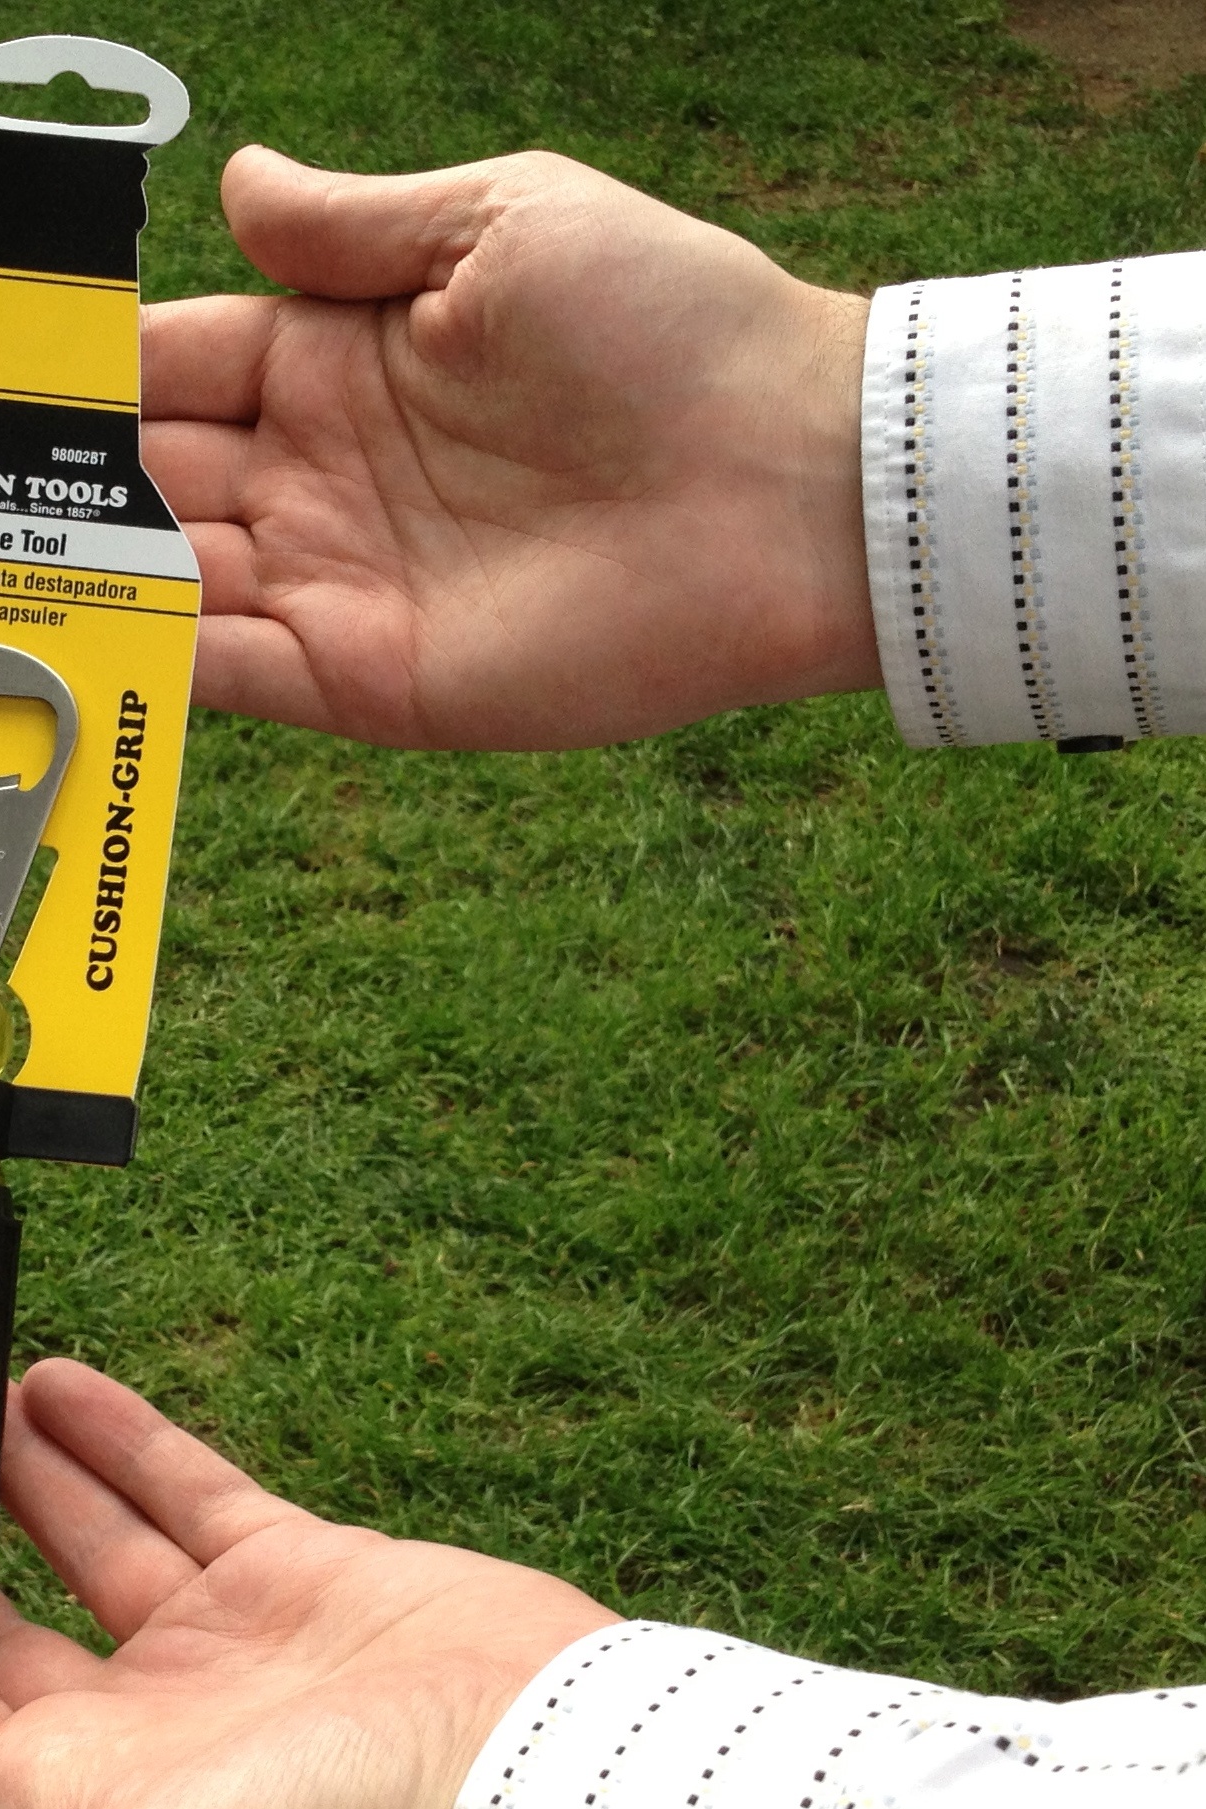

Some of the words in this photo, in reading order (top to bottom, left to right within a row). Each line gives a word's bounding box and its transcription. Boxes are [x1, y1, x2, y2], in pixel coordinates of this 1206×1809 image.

[51, 447, 108, 466] 98002BT
[25, 476, 129, 508] TOOLS
[30, 502, 63, 517] Since
[20, 529, 68, 557] Tool
[24, 571, 138, 601] destapadora
[86, 690, 148, 992] CUSHION-GRIP
